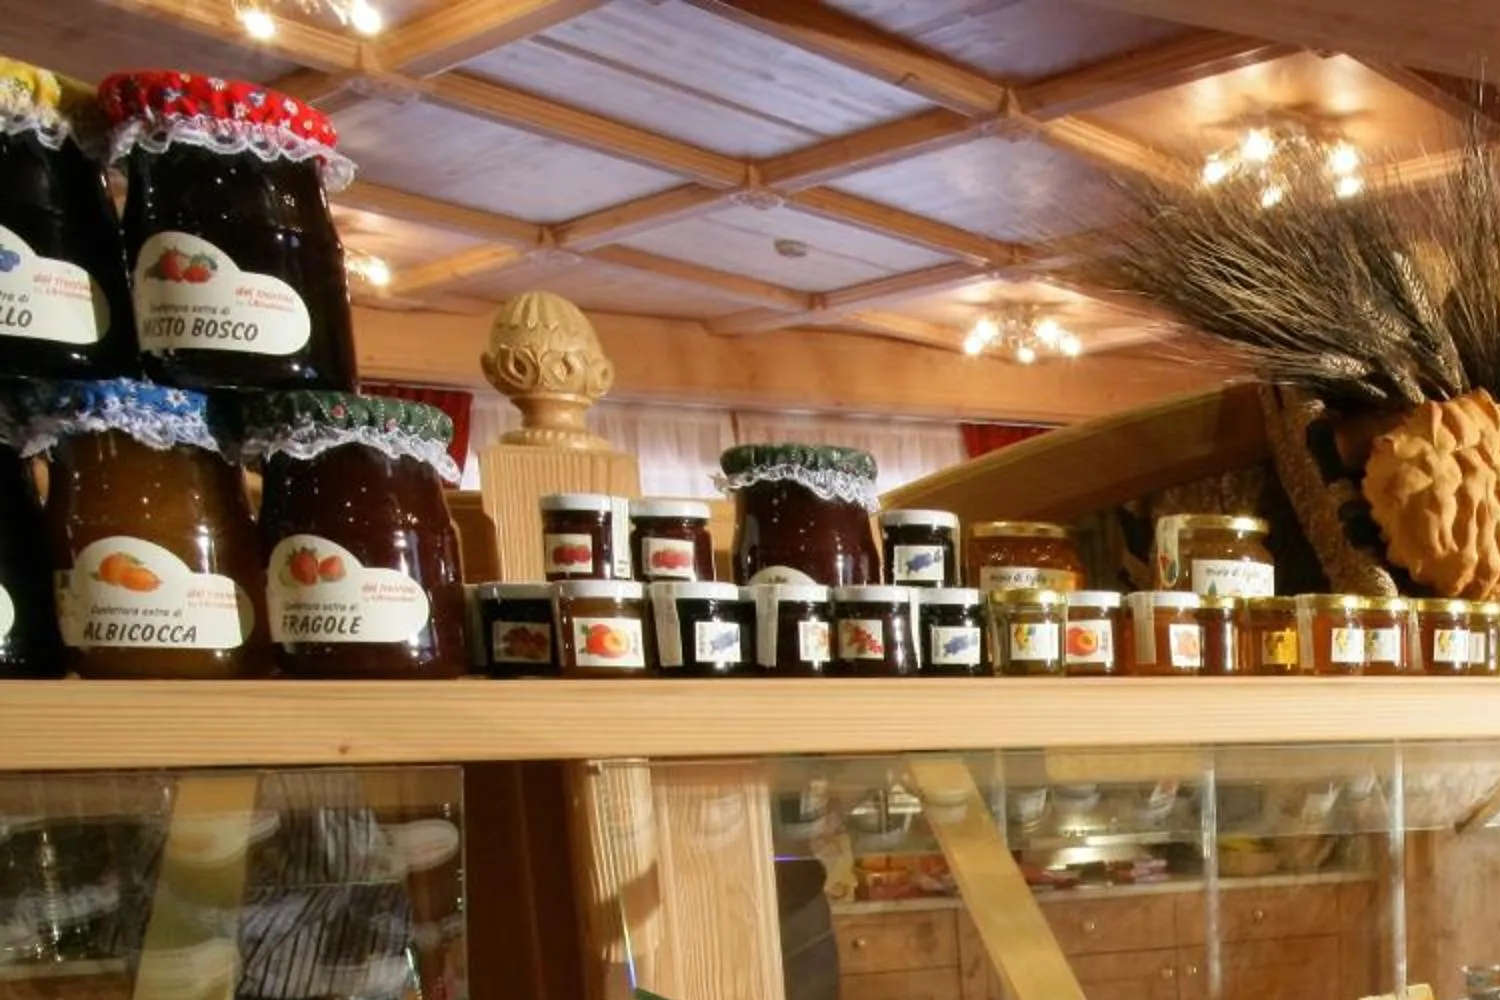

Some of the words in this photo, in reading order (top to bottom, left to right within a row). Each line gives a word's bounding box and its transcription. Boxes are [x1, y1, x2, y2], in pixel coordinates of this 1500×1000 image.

[191, 317, 259, 341] BOSCO
[84, 622, 197, 643] ALBICOCCA
[282, 614, 361, 635] FRAGOLE
